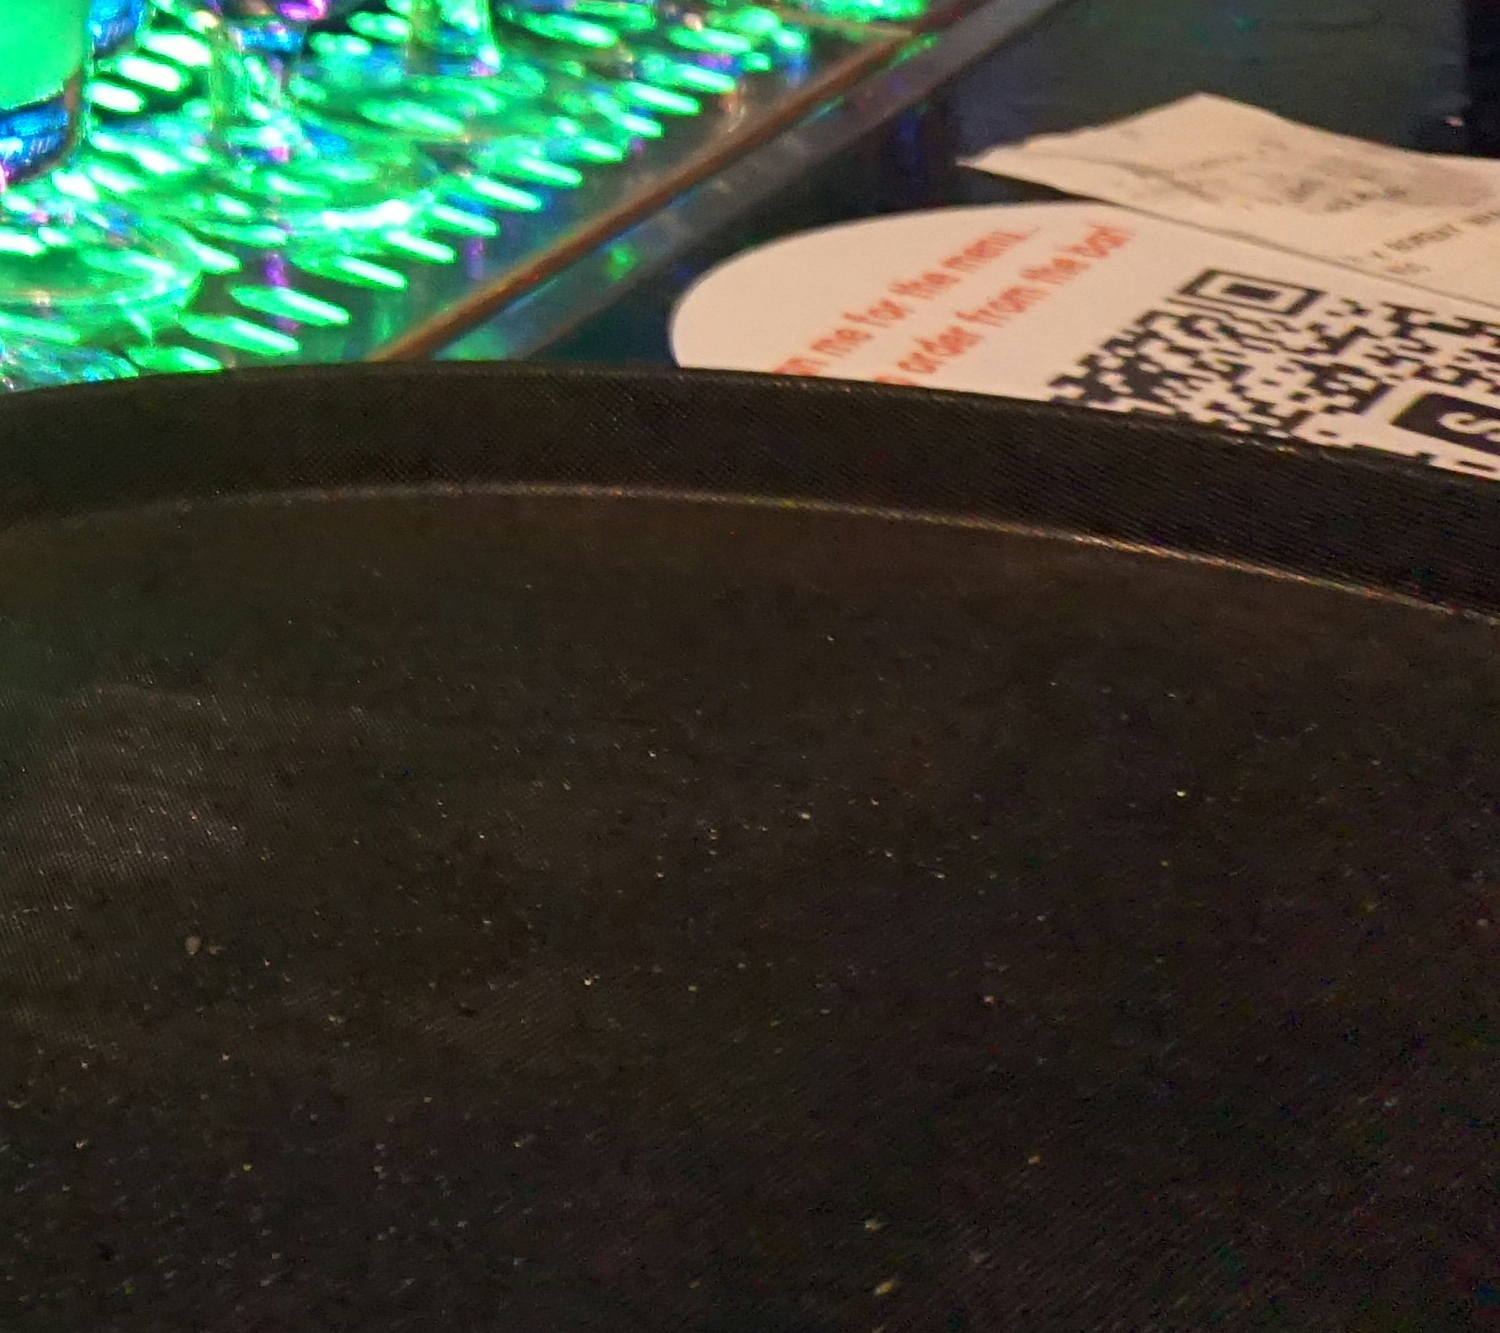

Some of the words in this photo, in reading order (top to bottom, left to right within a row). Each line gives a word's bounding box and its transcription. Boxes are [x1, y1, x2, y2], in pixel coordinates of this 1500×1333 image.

[887, 270, 961, 301] the
[954, 284, 1052, 328] from
[1019, 255, 1092, 287] the
[840, 298, 914, 329] for
[809, 327, 873, 357] me
